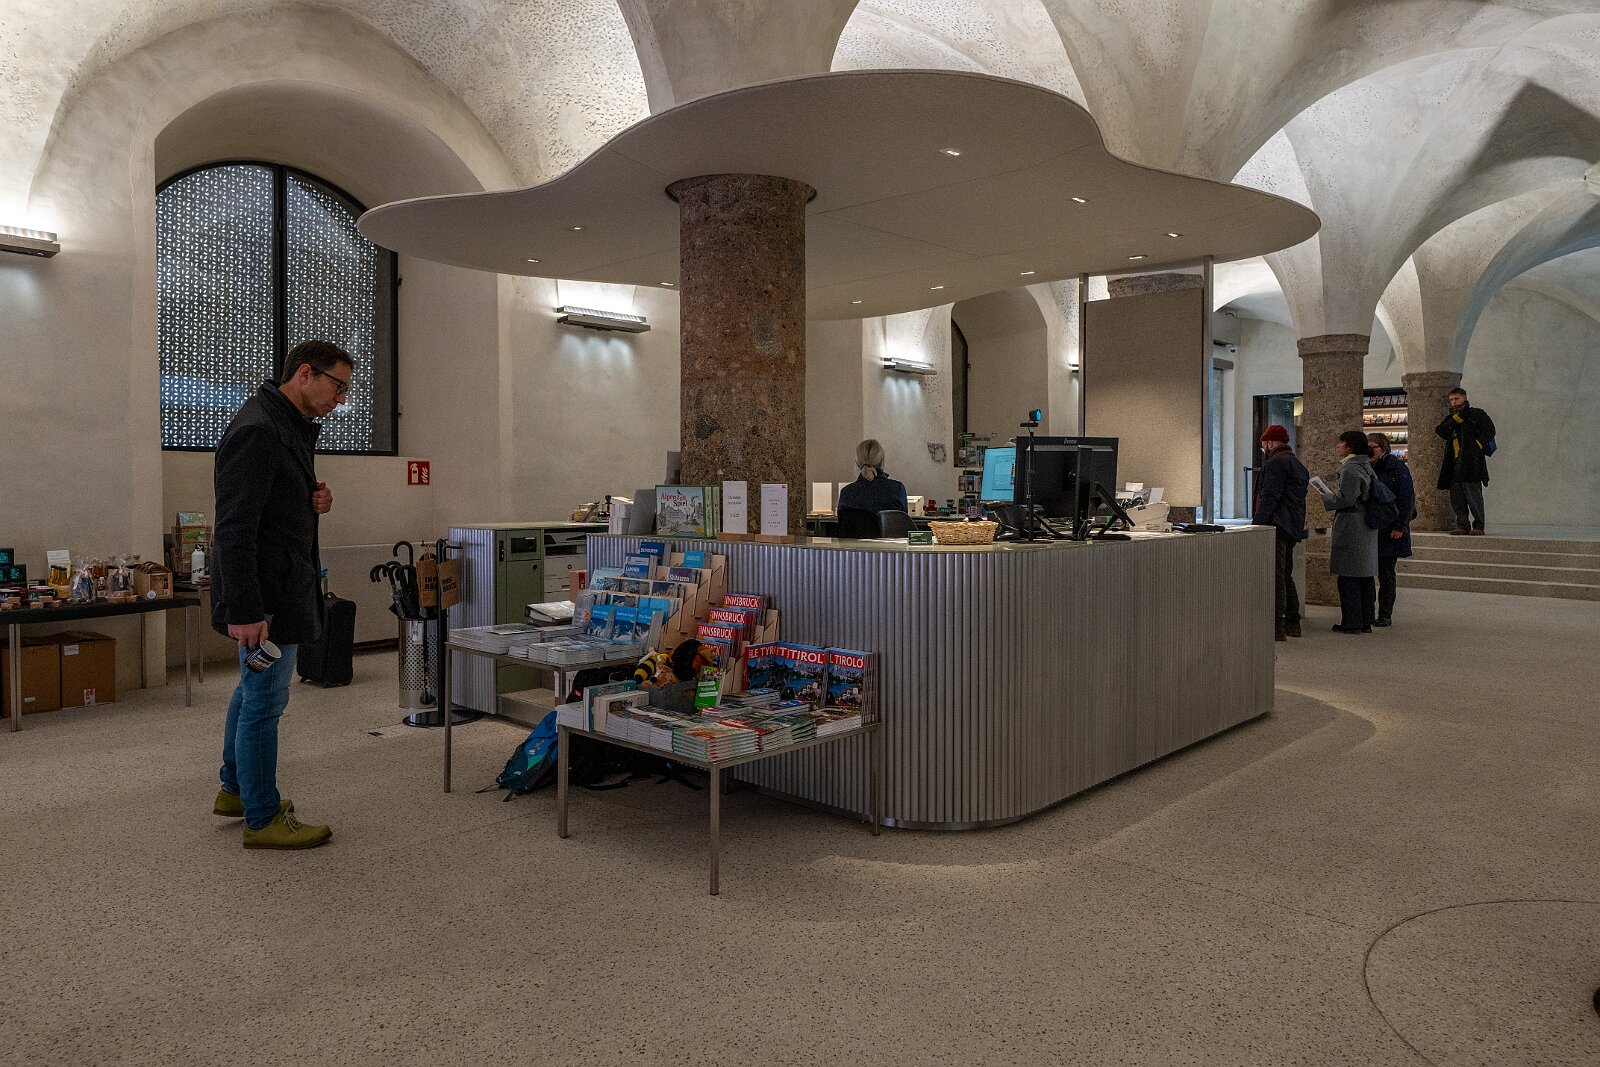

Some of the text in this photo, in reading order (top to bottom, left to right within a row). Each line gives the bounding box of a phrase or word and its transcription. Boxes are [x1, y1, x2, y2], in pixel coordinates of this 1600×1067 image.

[724, 595, 760, 608] INNSBRUCK
[711, 610, 745, 624] INNSBRUCK
[700, 625, 733, 639] INNSBRUCK
[760, 646, 776, 657] TYR
[789, 649, 824, 664] TIROL
[834, 654, 864, 669] TIROLO
